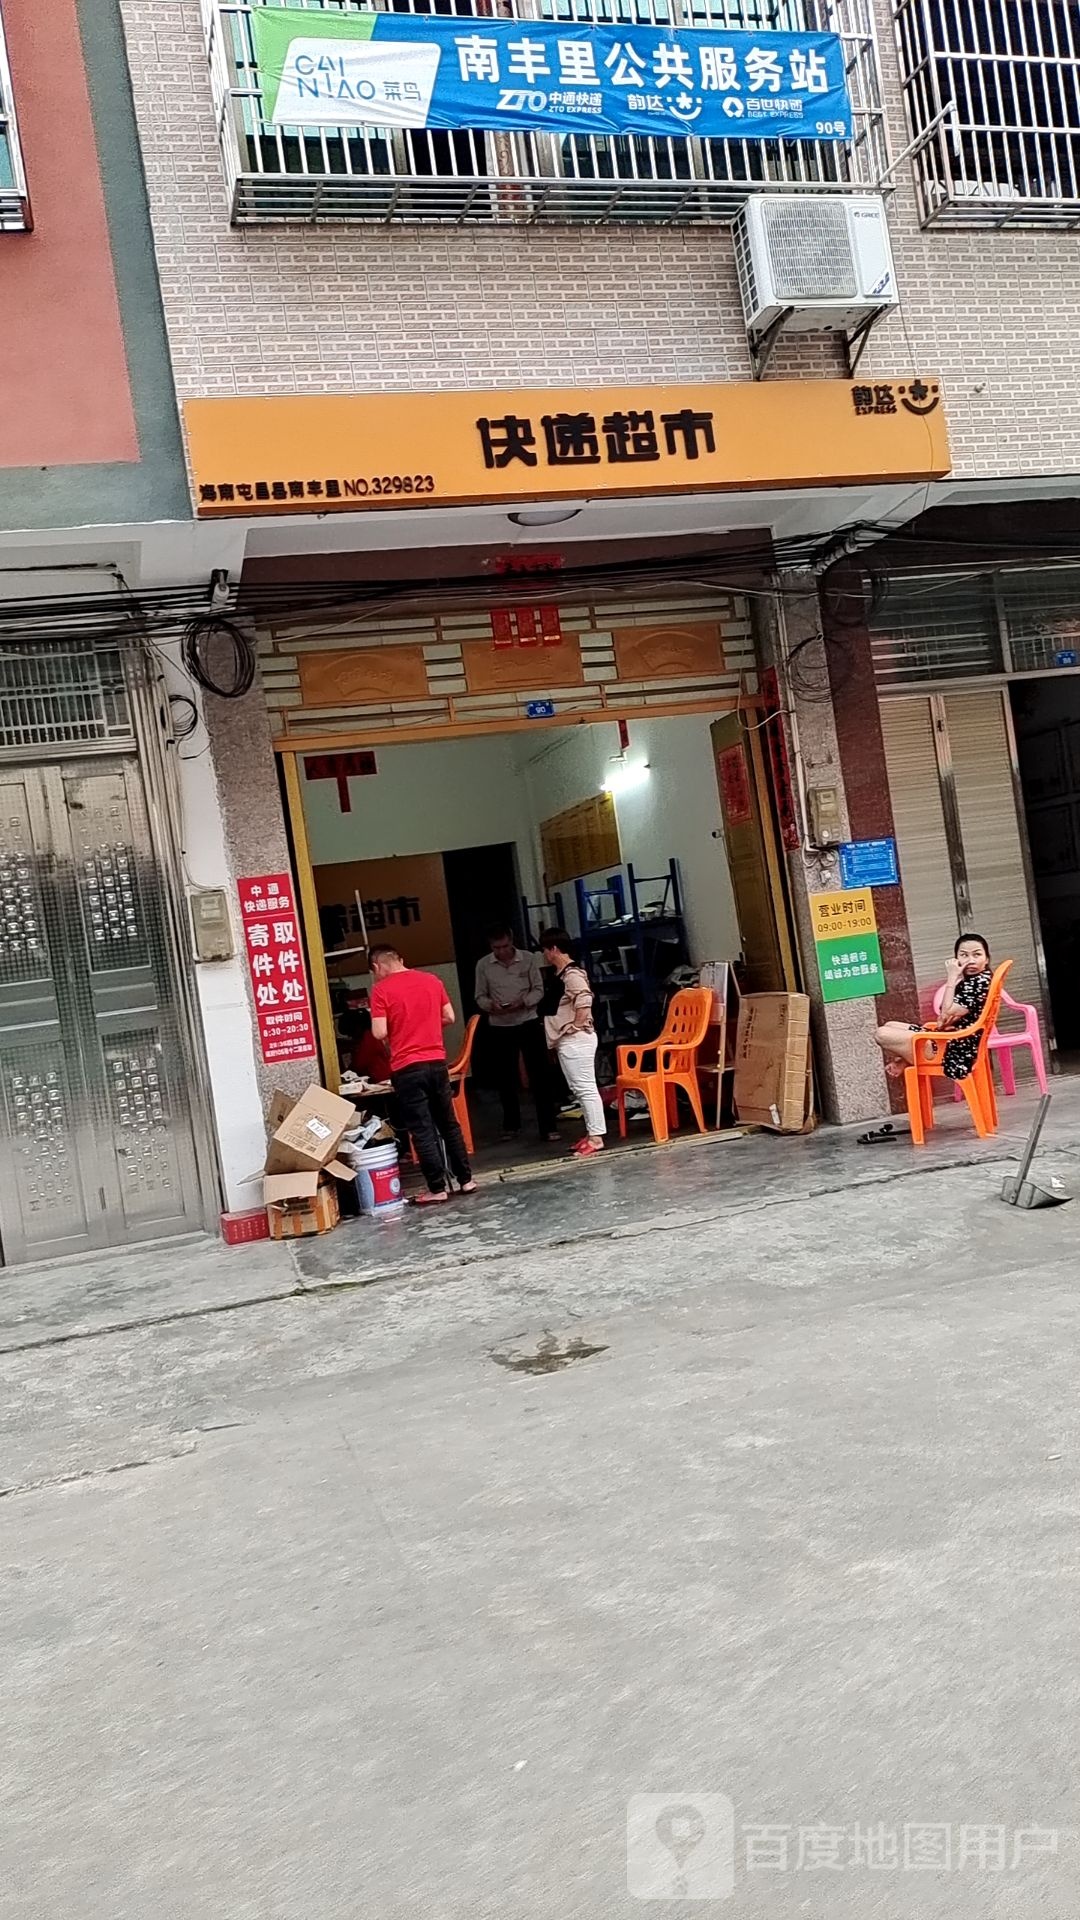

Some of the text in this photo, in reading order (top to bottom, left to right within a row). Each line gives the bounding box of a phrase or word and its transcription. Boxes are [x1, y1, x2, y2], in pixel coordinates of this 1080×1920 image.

[295, 55, 344, 77] CAI
[454, 34, 829, 93] 南丰里公共服务站
[296, 73, 422, 101] NIAO 菜鸟
[495, 89, 548, 112] ZTO
[548, 91, 603, 107] 中通快递
[627, 93, 664, 112] 韵达
[746, 98, 803, 112] 百世快递
[548, 105, 603, 114] ZTO EXPRESS
[815, 120, 847, 137] 90号
[851, 384, 896, 406] 韵达
[855, 405, 898, 416] EXPRESS
[476, 409, 716, 469] 快递超市
[243, 896, 290, 913] 快递服务
[818, 899, 866, 918] 营业时间
[817, 917, 872, 933] 09:00-19:00
[265, 1011, 303, 1026] 取件时间
